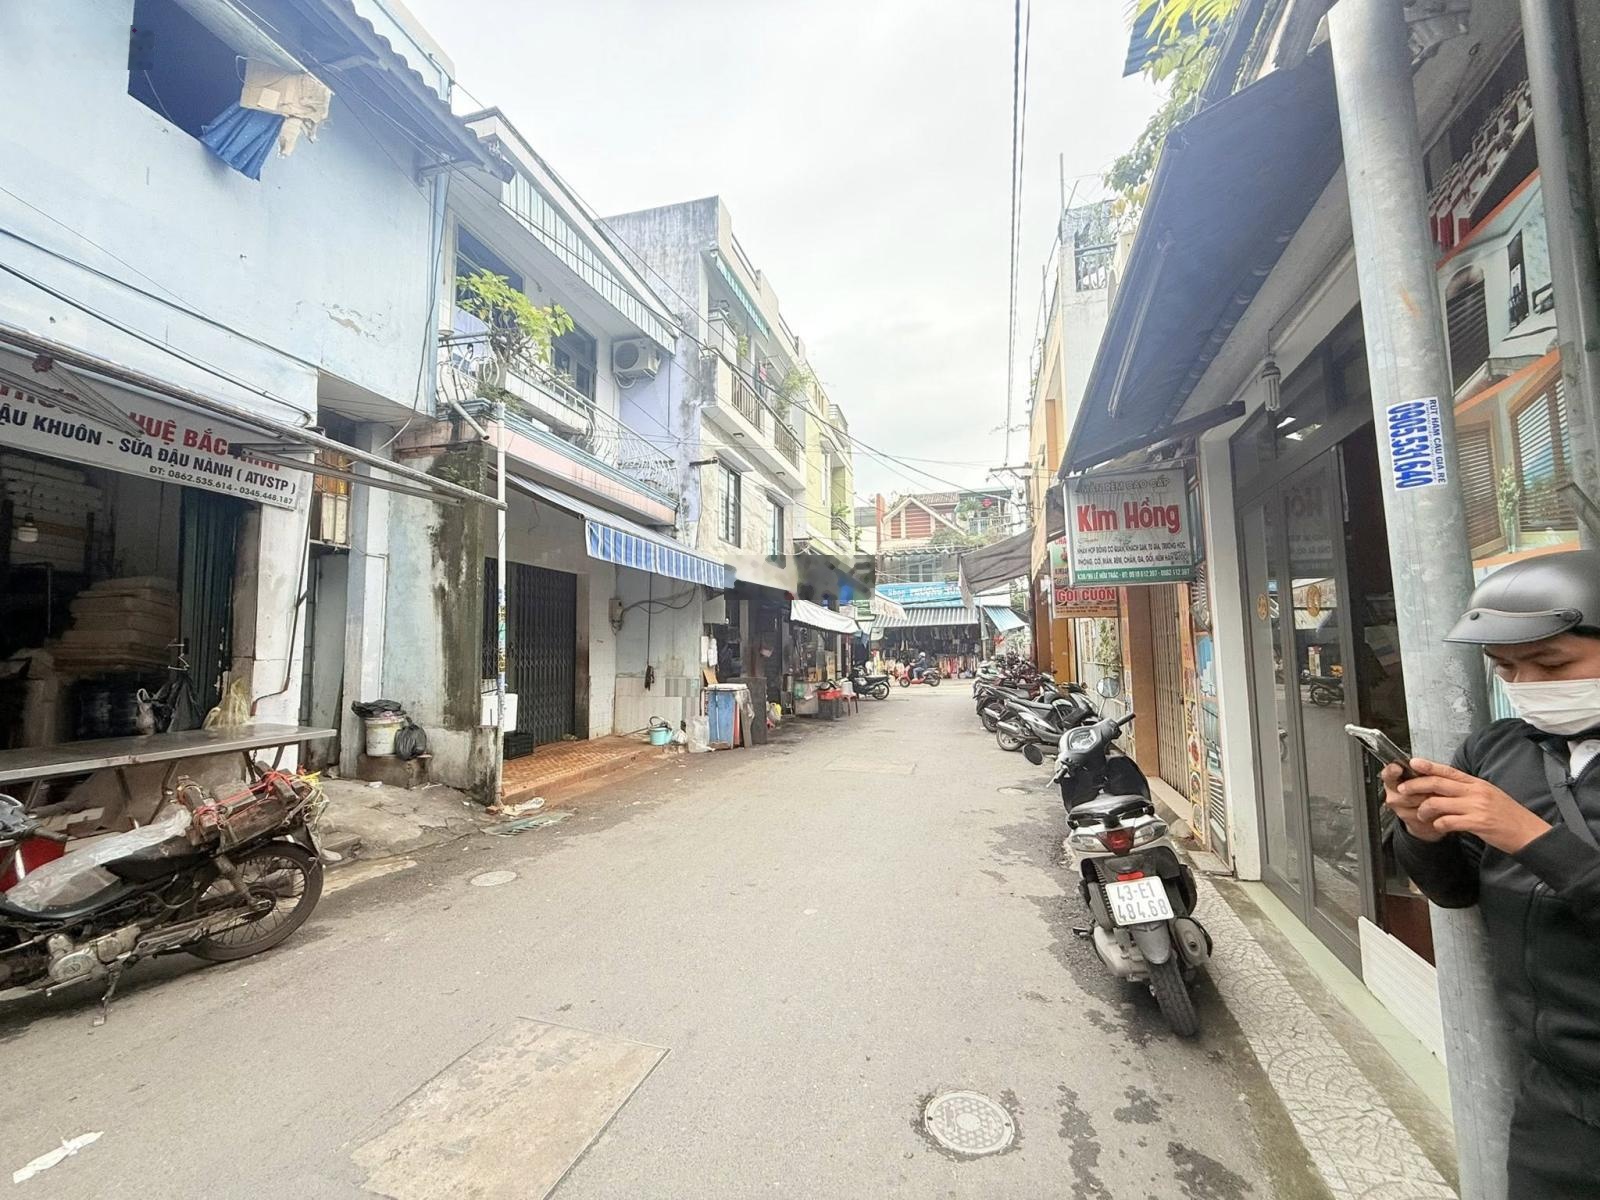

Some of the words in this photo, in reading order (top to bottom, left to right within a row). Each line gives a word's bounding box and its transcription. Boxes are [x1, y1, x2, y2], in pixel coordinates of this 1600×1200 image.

[33, 414, 103, 445] KHUÔN
[119, 437, 153, 459] SỮA
[157, 447, 189, 467] ĐẬU
[193, 456, 233, 478] NÀNH
[244, 471, 289, 491] ATVSTP
[183, 428, 228, 456] BẮC
[1388, 402, 1433, 488] 0905.531.640
[149, 465, 165, 476] ĐT:
[168, 470, 232, 491] 0862.535.614
[239, 485, 294, 505] 0345.448.187
[1077, 504, 1118, 532] Kim
[1116, 881, 1156, 902] 43-E1
[1117, 898, 1169, 921] 484.68
